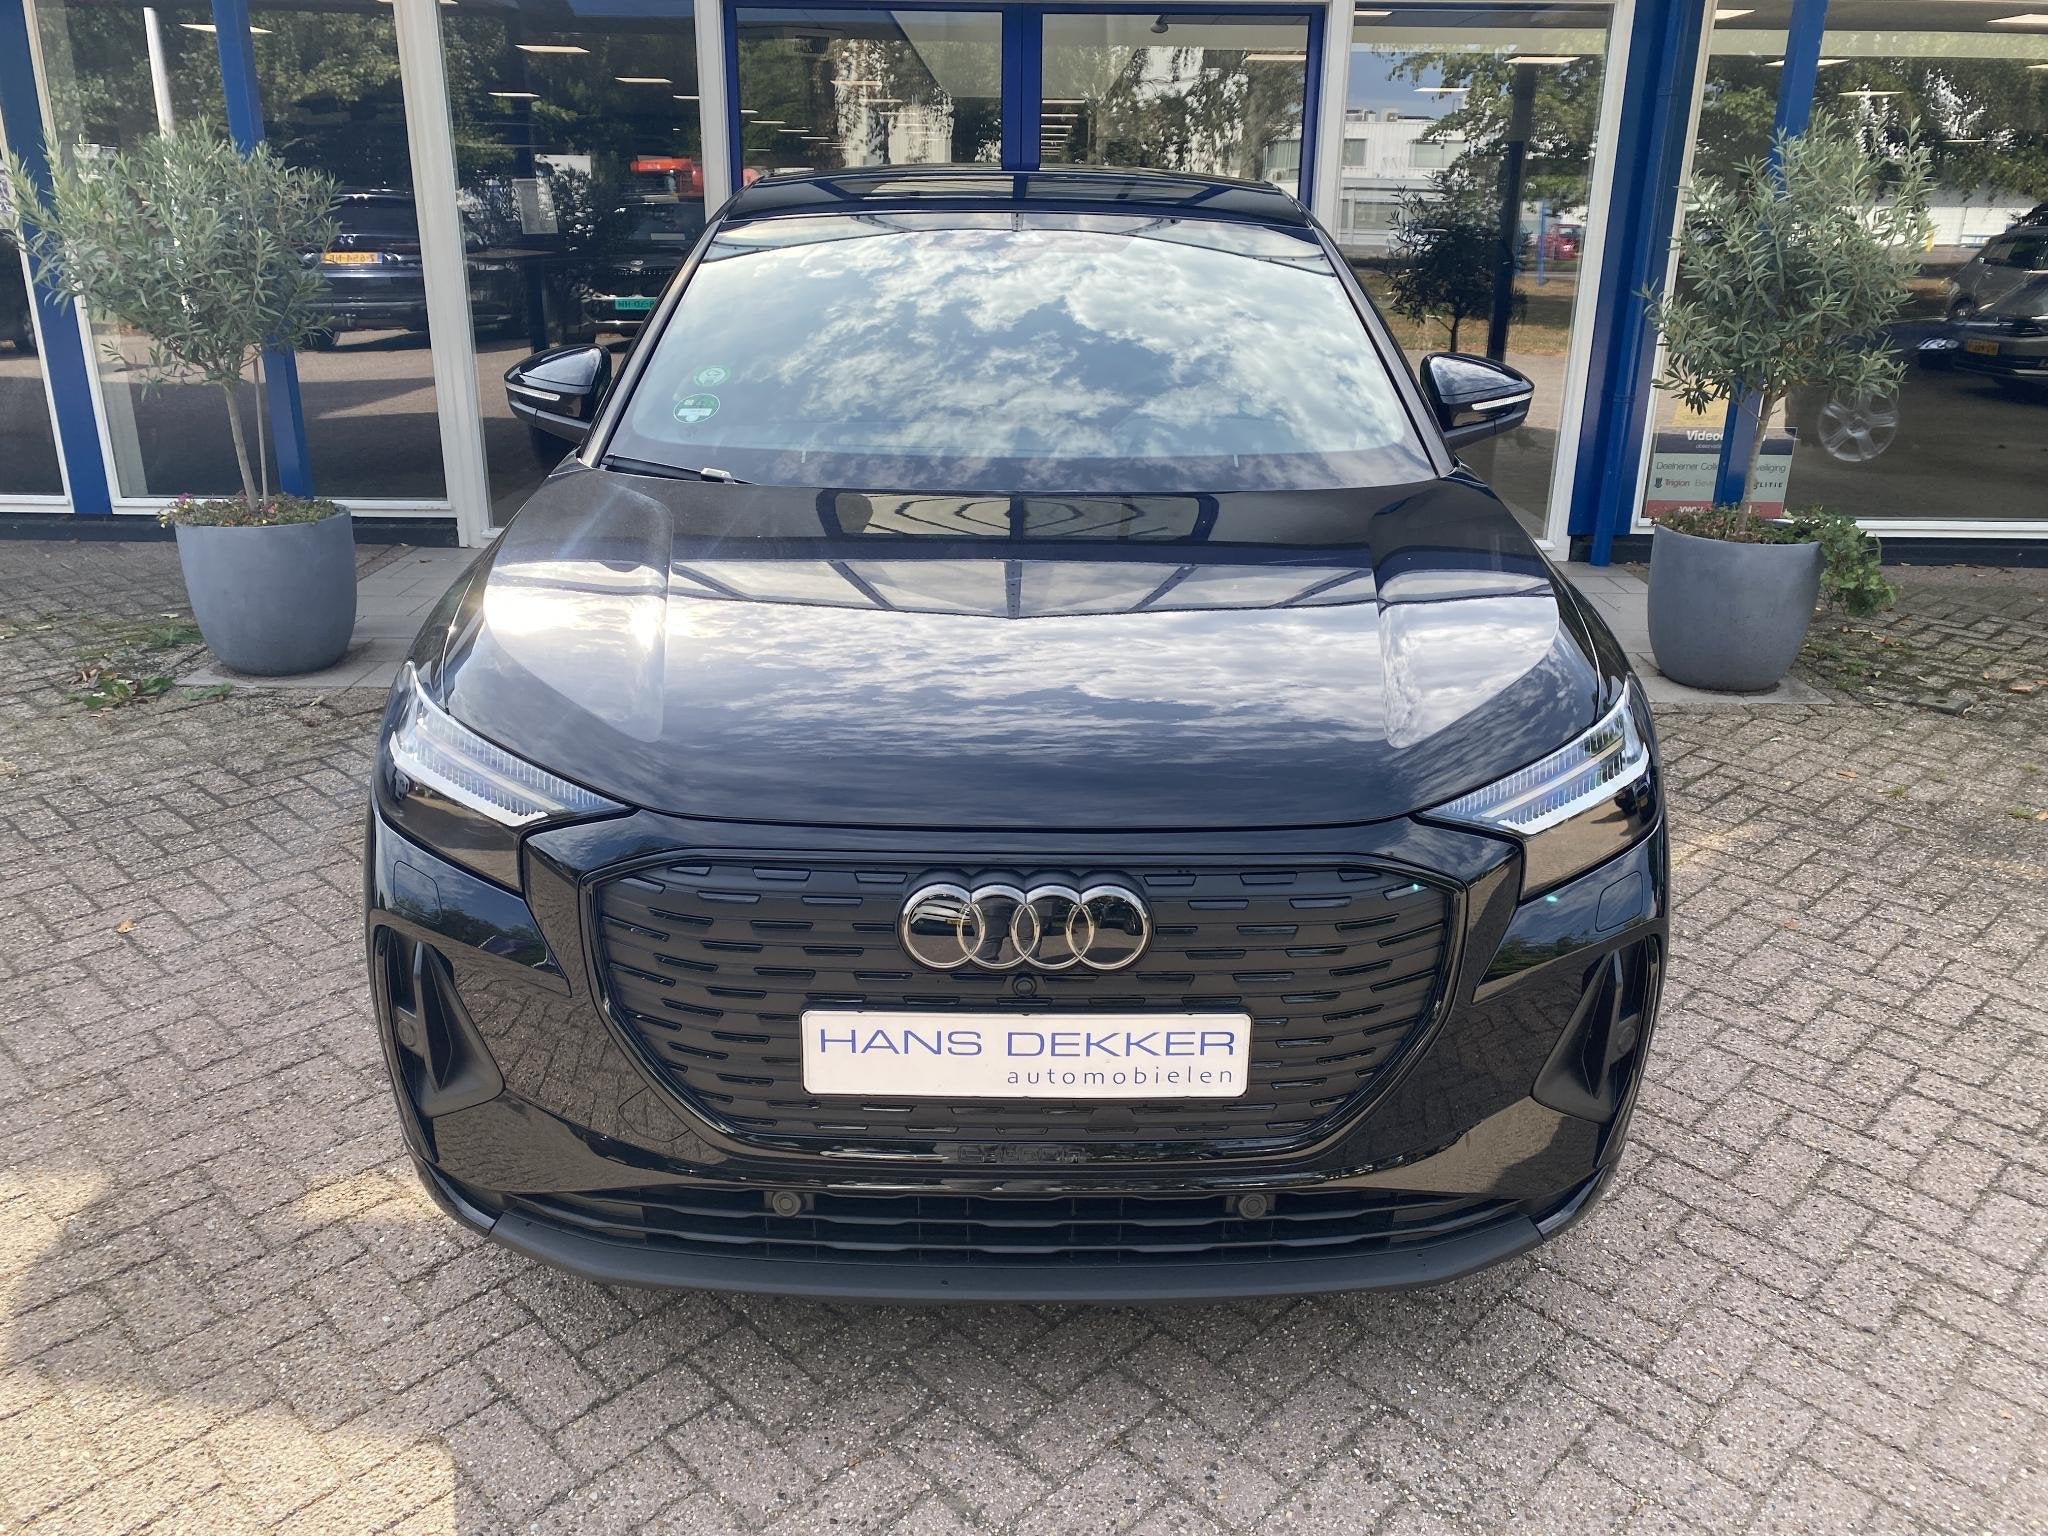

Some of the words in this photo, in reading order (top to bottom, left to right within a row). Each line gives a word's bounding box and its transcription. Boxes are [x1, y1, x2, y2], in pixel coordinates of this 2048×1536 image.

[1656, 461, 1699, 471] Deelnemer
[819, 1028, 982, 1057] HANS
[1007, 1031, 1236, 1057] DEKKER
[1007, 1066, 1234, 1085] automobielen
